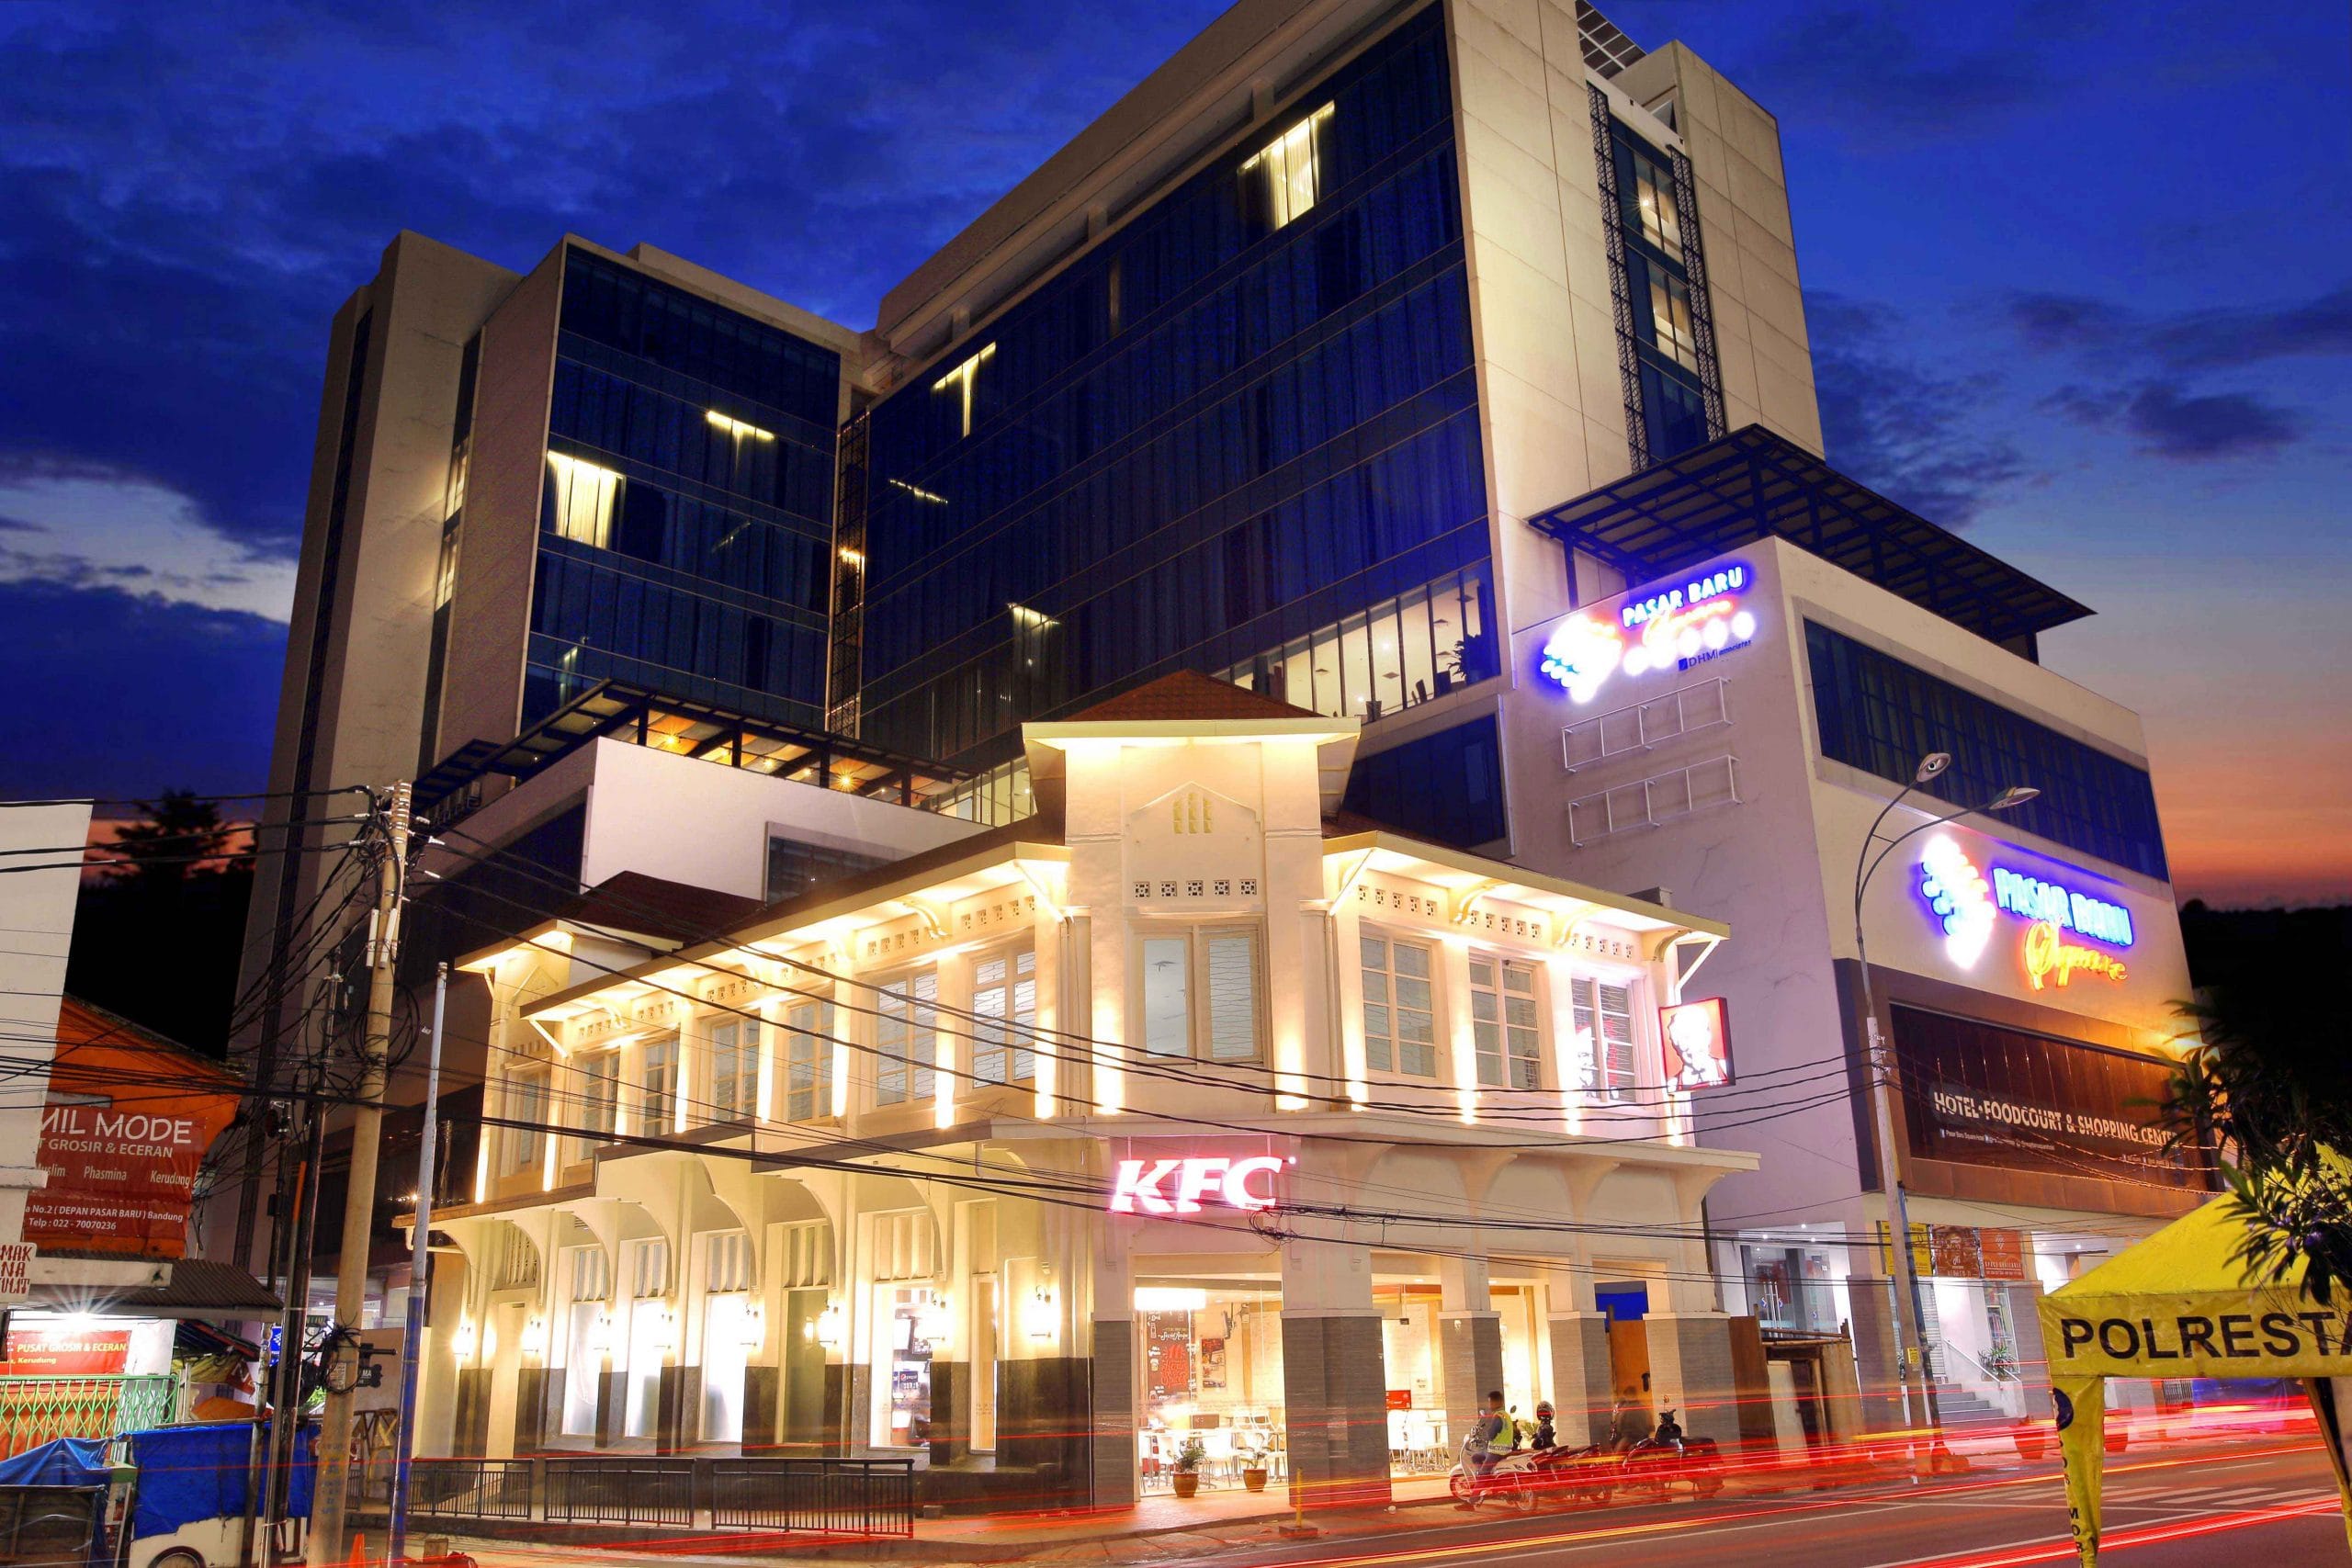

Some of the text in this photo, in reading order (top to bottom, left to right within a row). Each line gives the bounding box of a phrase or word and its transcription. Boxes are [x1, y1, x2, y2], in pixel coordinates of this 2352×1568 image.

[1622, 589, 1684, 627] PASAR
[1688, 566, 1744, 604] BARU
[1689, 649, 1717, 667] DHM
[95, 1112, 193, 1144] MODE
[2066, 1114, 2076, 1133] &
[2078, 1115, 2139, 1142] SHOPPING
[49, 1138, 102, 1153] GROSIR
[105, 1143, 116, 1154] &
[119, 1144, 174, 1158] ECERAN
[84, 1166, 127, 1181] Phasmina
[151, 1170, 191, 1188] Kerudung
[1110, 1156, 1283, 1213] KFC
[32, 1205, 52, 1214] No.2
[59, 1206, 88, 1215] DEPAN
[90, 1208, 117, 1217] PASAR
[119, 1209, 141, 1218] BARU
[148, 1212, 184, 1223] Bandung
[53, 1219, 69, 1228] 022
[0, 1278, 30, 1294] ULIT
[2061, 1312, 2352, 1359] POLREST
[17, 1343, 127, 1353] PUSAT GROSIR & ECERAN
[18, 1357, 57, 1365] Kerudung
